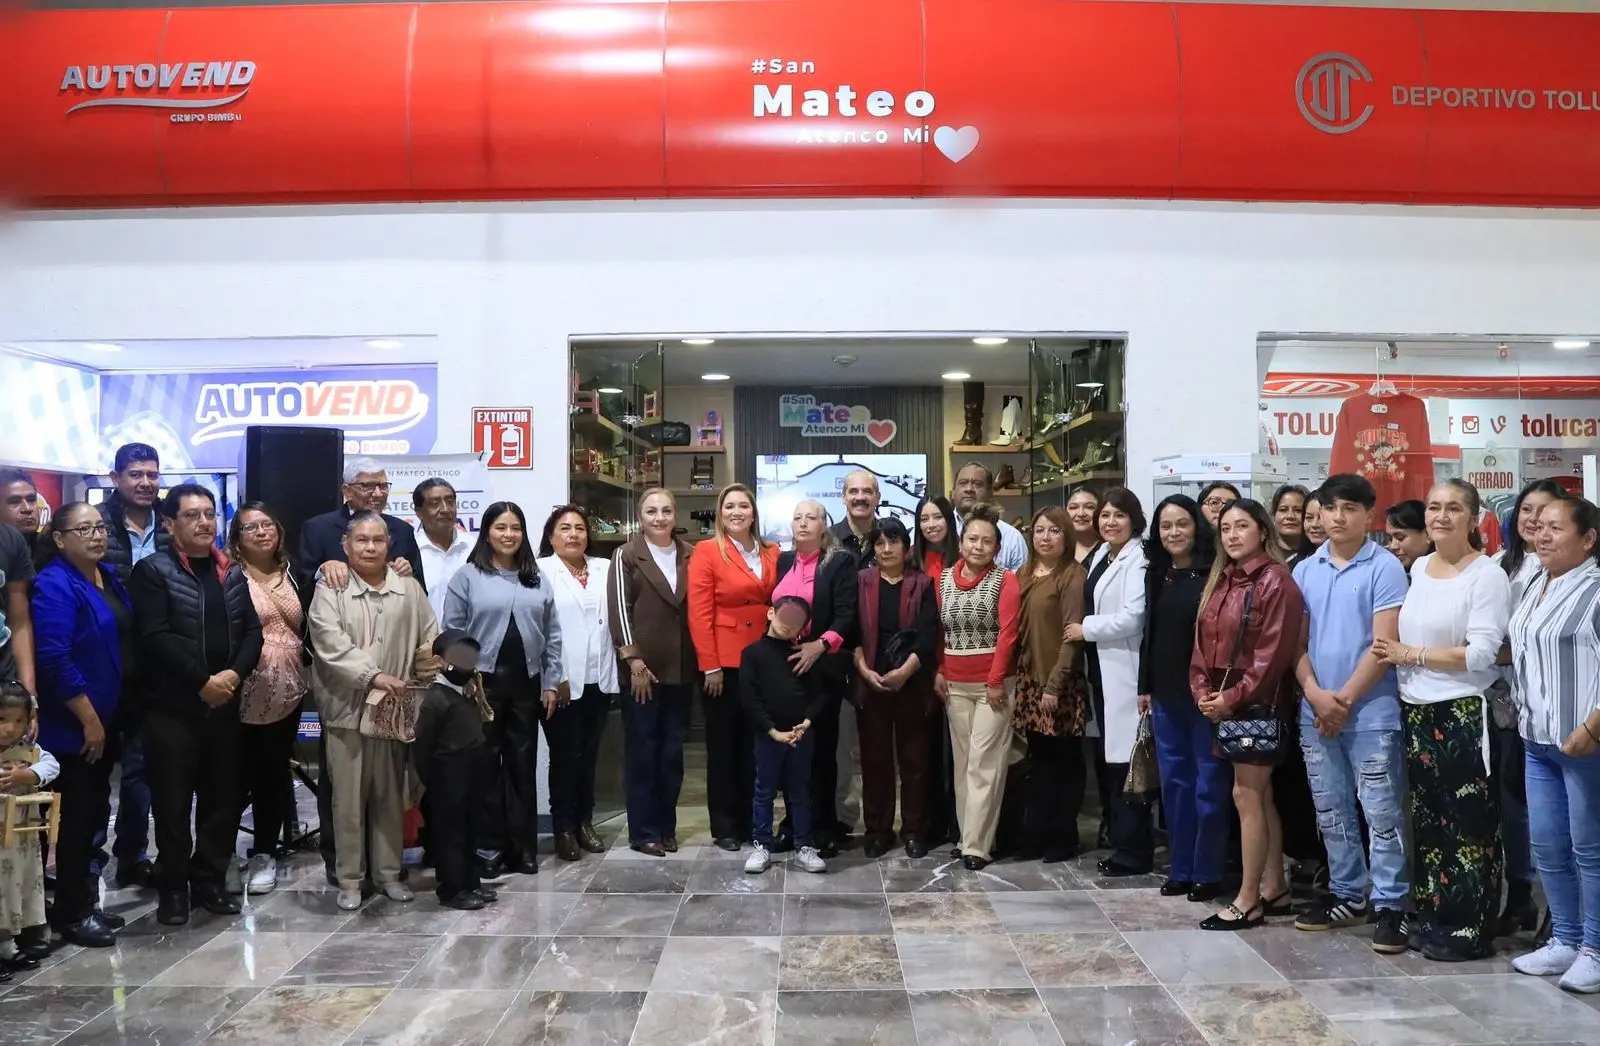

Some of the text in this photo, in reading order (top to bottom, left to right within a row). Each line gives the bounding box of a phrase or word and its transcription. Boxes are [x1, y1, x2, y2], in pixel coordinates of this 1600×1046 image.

[751, 58, 815, 74] #San
[60, 61, 257, 90] AUTOVEND
[753, 84, 935, 117] Mateo
[1392, 86, 1535, 109] DEPORTIVO
[796, 125, 929, 143] Atenco Mi
[201, 385, 413, 418] AUTOVEND
[782, 395, 813, 405] #San
[476, 411, 528, 423] EXTINTOR
[783, 405, 866, 424] Mateo
[805, 423, 865, 434] Atenco Mi
[1521, 413, 1600, 437] toluca
[427, 469, 461, 477] ATENCO
[1468, 471, 1514, 489] CERRADO
